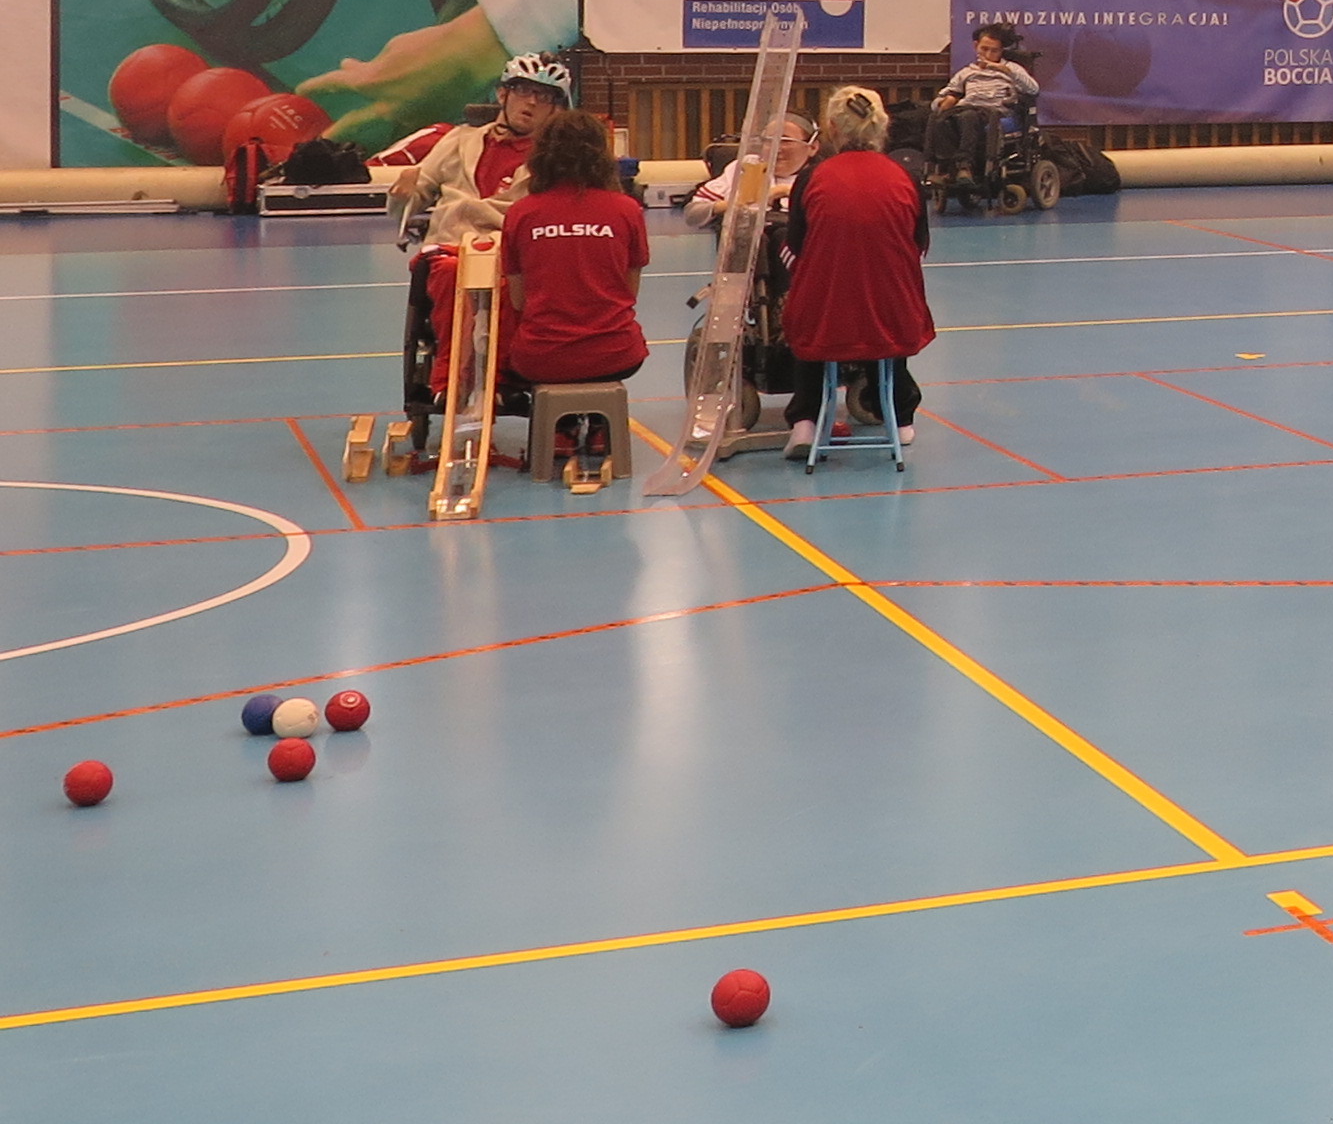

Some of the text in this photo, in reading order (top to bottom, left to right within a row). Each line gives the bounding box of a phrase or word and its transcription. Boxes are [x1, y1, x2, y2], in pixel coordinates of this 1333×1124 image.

[692, 2, 767, 15] Rehabilitacji
[966, 11, 1229, 26] PRAWDZIWA INTEGRACJA!
[1264, 48, 1333, 67] POLSKA
[1263, 67, 1333, 86] BOCCIA
[531, 224, 614, 240] POLSKA
